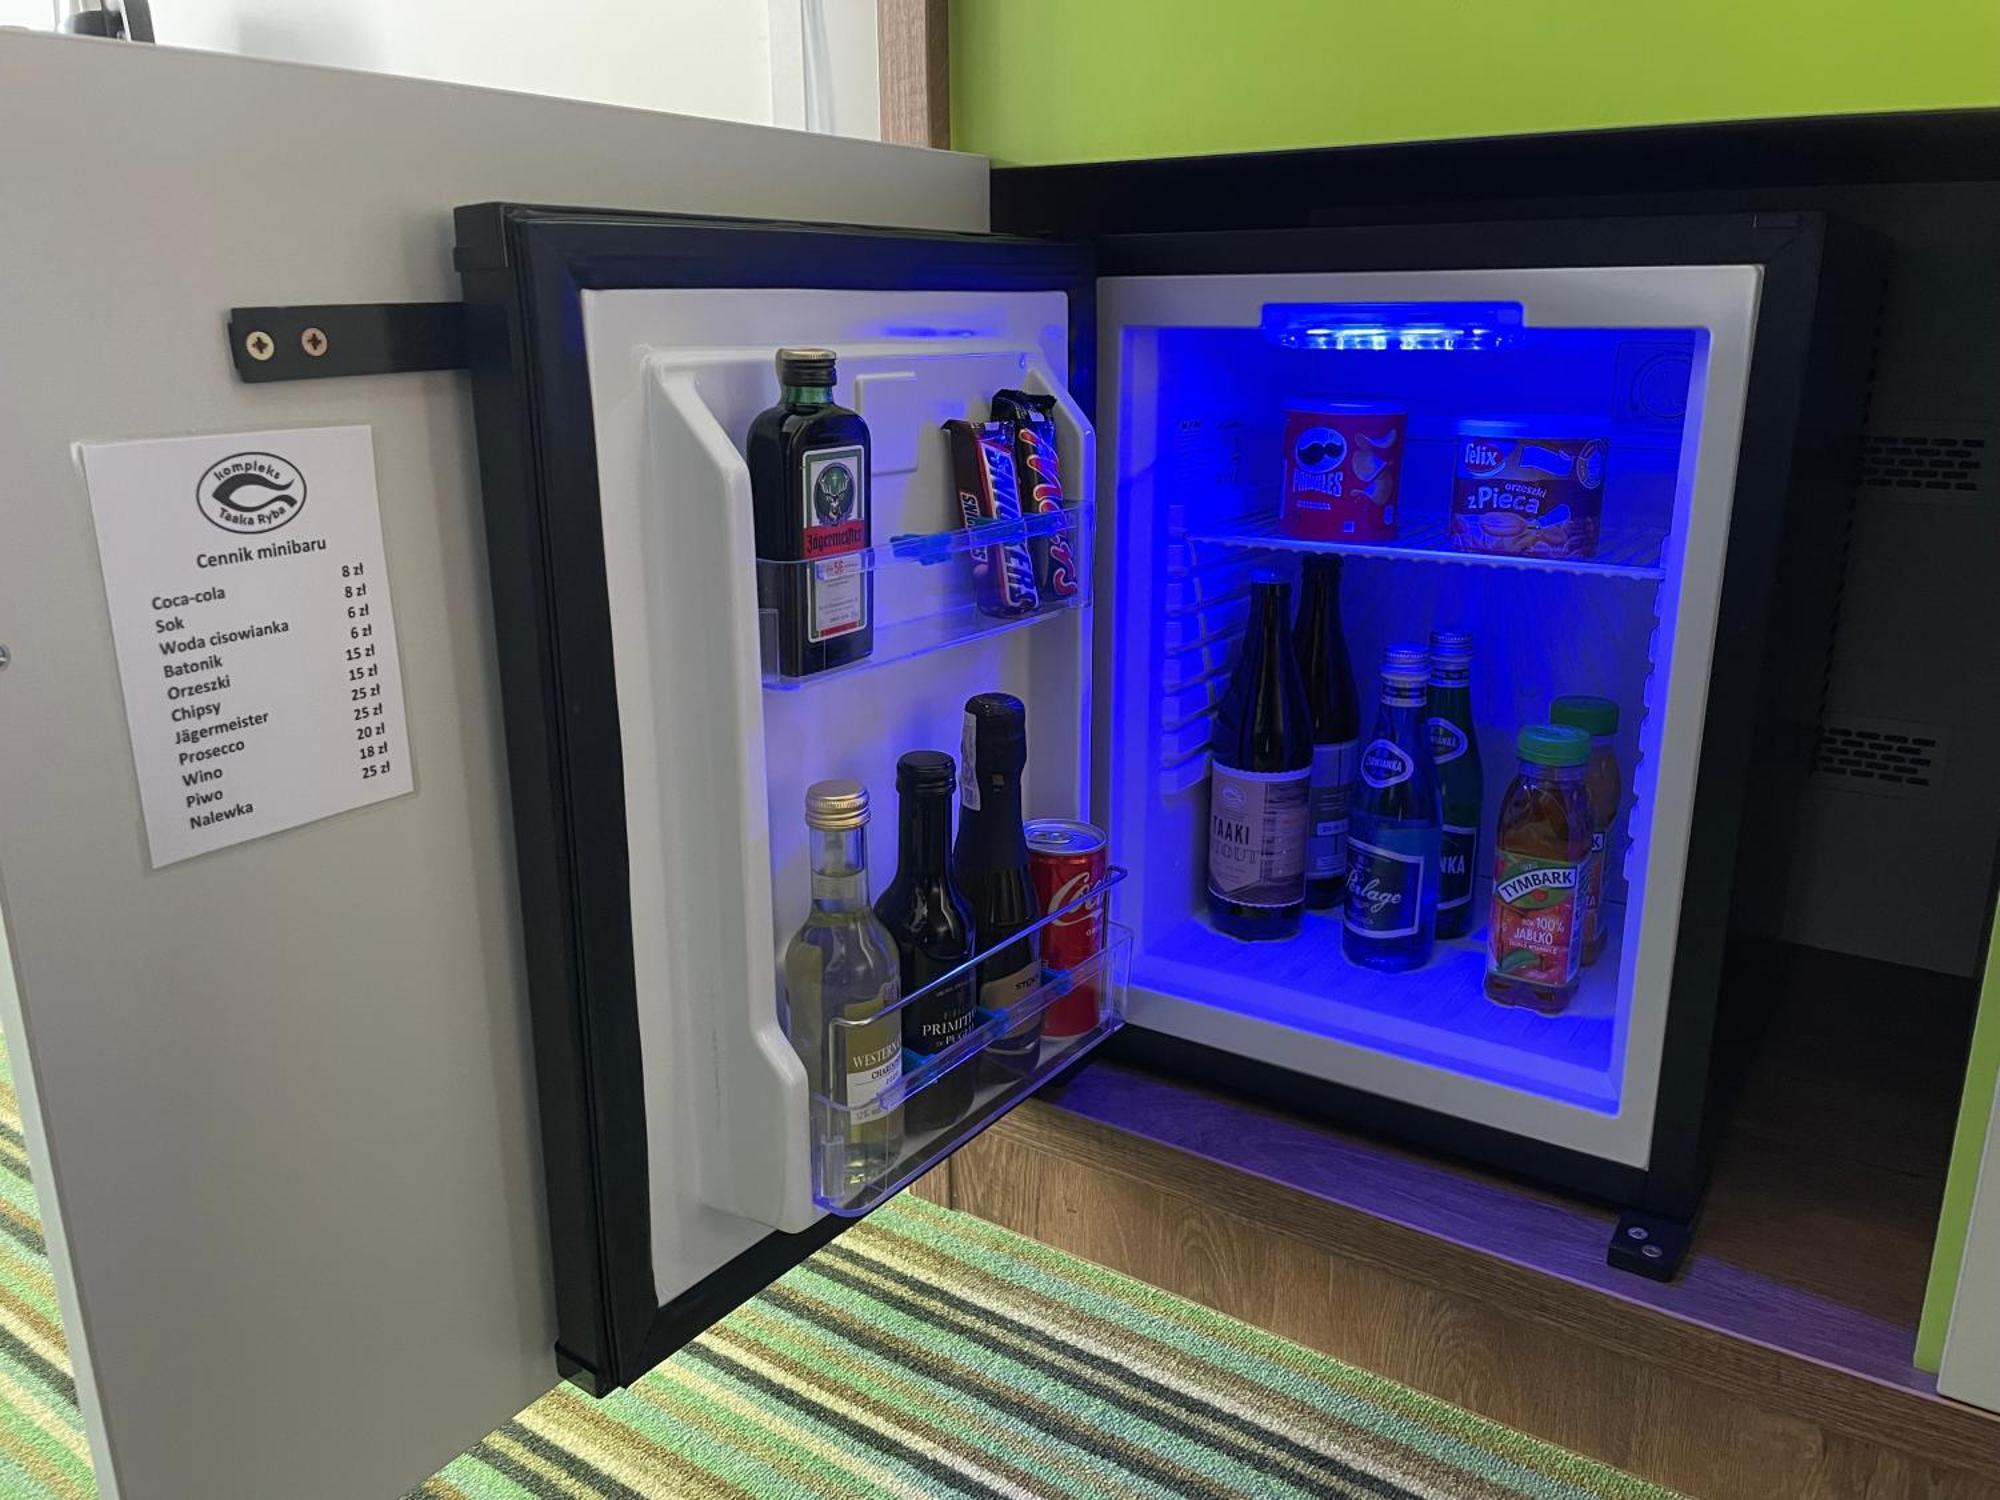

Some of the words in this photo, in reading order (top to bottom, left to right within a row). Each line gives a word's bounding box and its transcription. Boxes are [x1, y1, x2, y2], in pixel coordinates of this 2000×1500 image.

[213, 460, 281, 481] kompleks
[1464, 443, 1499, 467] felix
[219, 506, 255, 526] Taaka
[257, 506, 287, 525] Ryba
[1478, 486, 1540, 514] Pieca
[1505, 483, 1547, 499] orzeszki
[196, 548, 254, 570] Cennik
[257, 537, 327, 562] minibaru
[151, 586, 226, 611] Coca-cola
[341, 564, 351, 578] 8
[352, 561, 364, 577] zł
[155, 616, 185, 634] Sok
[344, 585, 354, 599] 8
[355, 582, 367, 597] zł
[159, 635, 206, 656] Woda
[209, 620, 290, 647] cisowianka
[347, 605, 357, 619] 6
[358, 602, 370, 617] zł
[163, 654, 224, 679] Batonik
[350, 626, 360, 640] 6
[361, 623, 373, 637] zł
[167, 674, 232, 701] Orzeszki
[345, 646, 362, 662] 15
[364, 643, 376, 657] zł
[171, 700, 222, 724] Chipsy
[348, 667, 365, 682] 15
[367, 663, 378, 677] zł
[175, 709, 270, 746] Jägermeister
[351, 686, 368, 702] 25
[369, 682, 381, 697] zł
[178, 735, 246, 766] Prosecco
[353, 706, 370, 721] 25
[372, 702, 383, 716] zł
[181, 765, 224, 788] Wino
[356, 725, 373, 741] 20
[375, 721, 385, 736] zł
[186, 787, 224, 810] Piwo
[359, 745, 376, 760] 18
[377, 740, 388, 755] zł
[190, 802, 255, 830] Nalewka
[361, 764, 378, 780] 25
[380, 760, 391, 774] zł
[1501, 870, 1573, 899] TYMBARK
